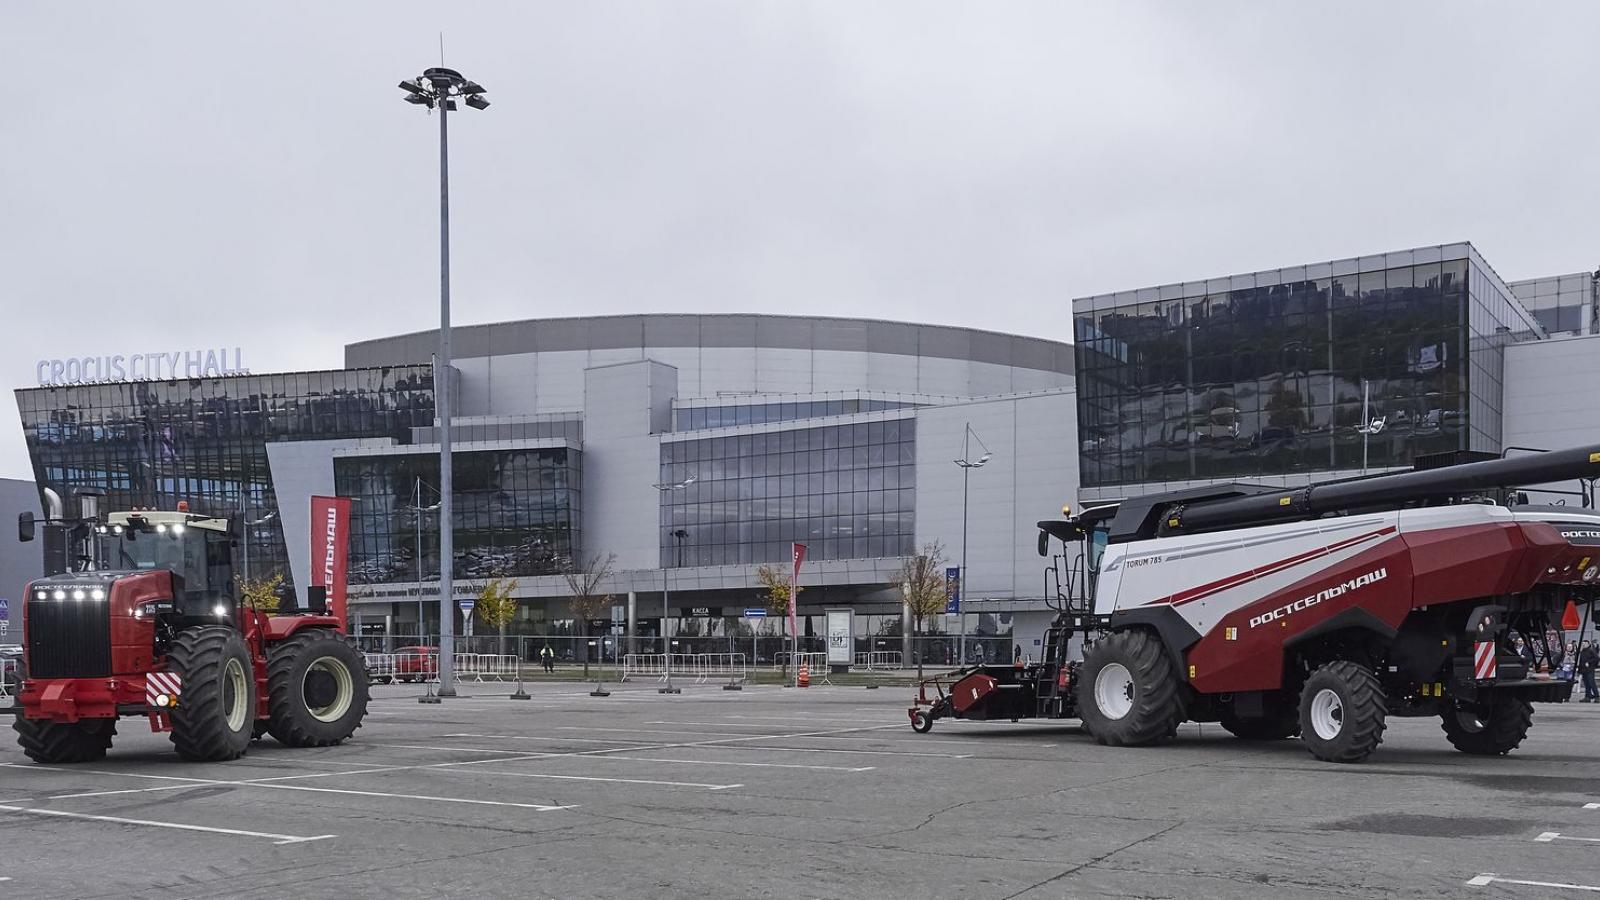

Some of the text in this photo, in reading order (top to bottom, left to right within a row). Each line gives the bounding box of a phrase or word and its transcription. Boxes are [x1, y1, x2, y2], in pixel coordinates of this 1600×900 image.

[37, 347, 249, 385] CROCUS CITY HALL
[1127, 556, 1162, 568] TORUM 785
[1249, 567, 1387, 628] РОСТСЕЛЬМАШ
